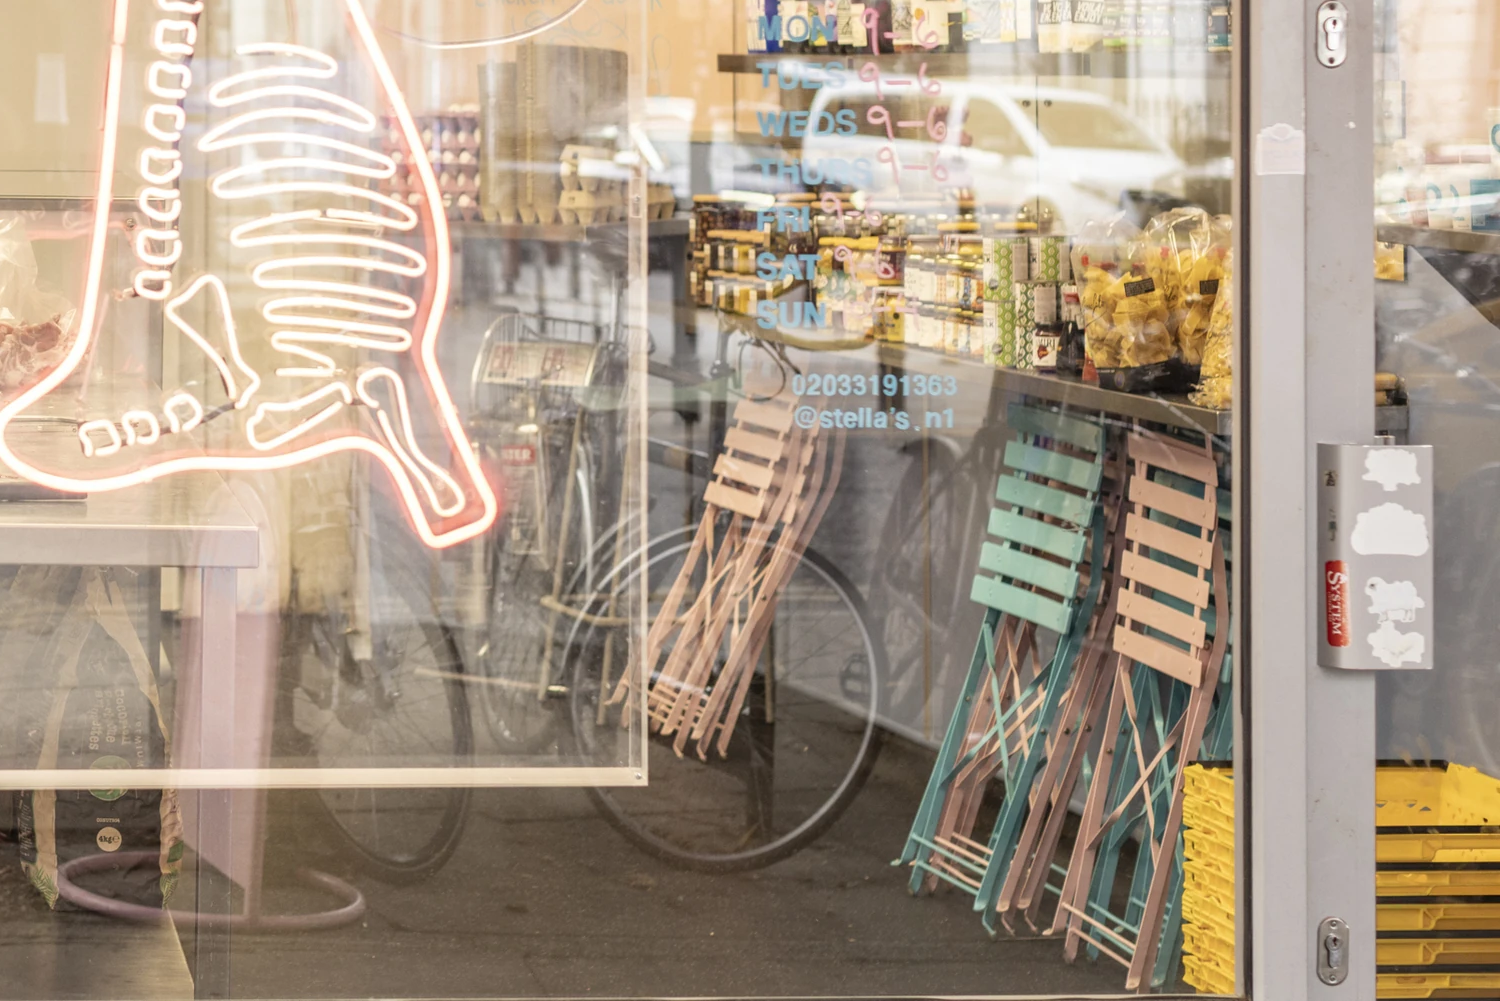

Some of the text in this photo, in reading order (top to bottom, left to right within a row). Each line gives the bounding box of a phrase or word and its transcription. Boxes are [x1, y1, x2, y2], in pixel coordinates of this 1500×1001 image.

[757, 15, 835, 42] MON
[756, 61, 846, 90] TUES
[756, 108, 858, 137] WEDS
[758, 157, 874, 187] THURS
[756, 205, 811, 233] FRI
[756, 251, 821, 281] SAT
[756, 300, 827, 329] SUN
[791, 373, 958, 397] 02033191363
[1326, 570, 1344, 635] SYSTEM
